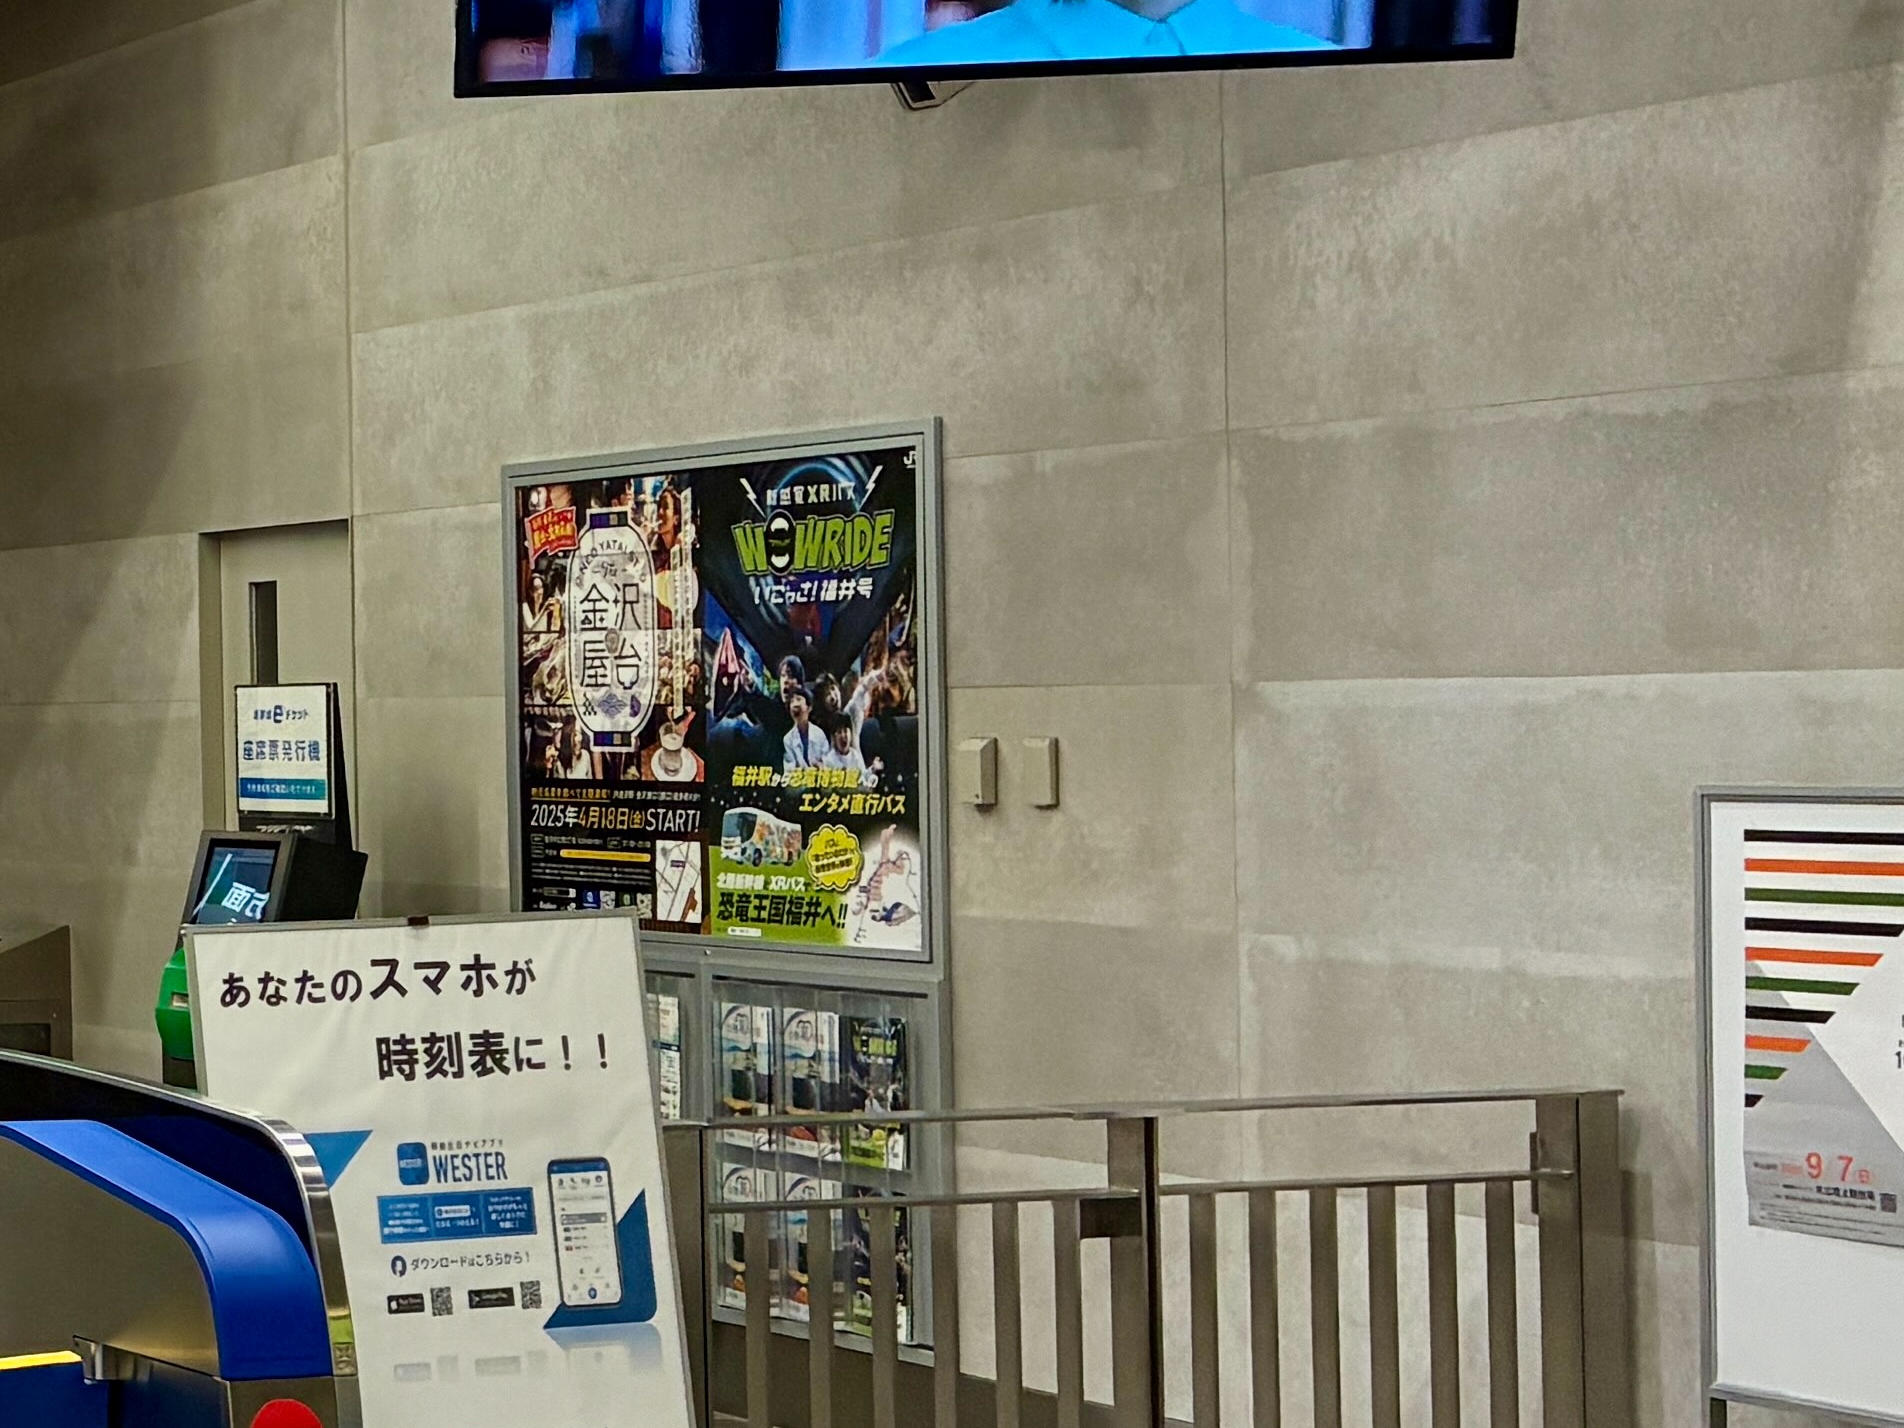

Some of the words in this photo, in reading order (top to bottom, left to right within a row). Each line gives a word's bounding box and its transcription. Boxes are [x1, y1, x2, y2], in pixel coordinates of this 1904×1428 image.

[798, 793, 906, 815] エンタメ直行バス
[219, 952, 536, 1009] あなたのスマホが
[375, 1030, 610, 1083] 時刻表に！！
[432, 1151, 508, 1184] WESTER
[1805, 1151, 1823, 1179] 9
[1837, 1155, 1854, 1182] 7
[410, 1251, 530, 1272] ダウンロードはこちらから！
